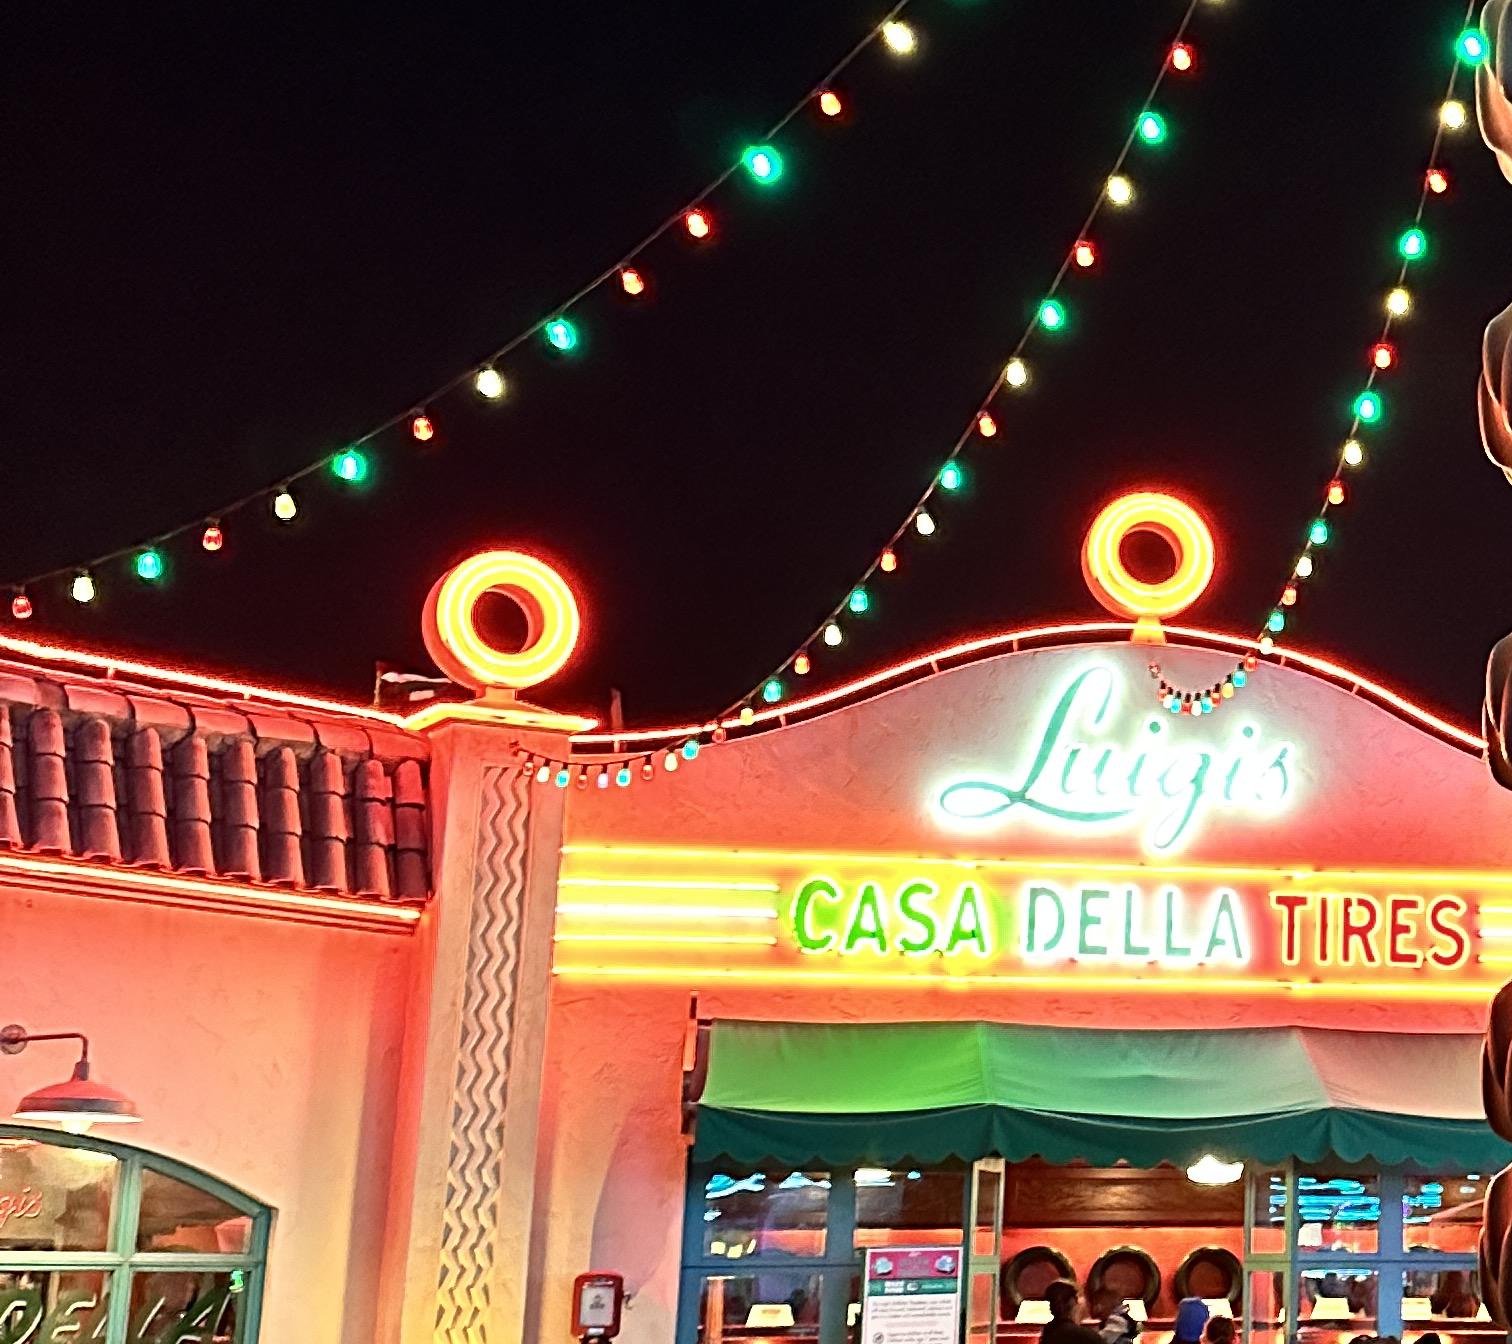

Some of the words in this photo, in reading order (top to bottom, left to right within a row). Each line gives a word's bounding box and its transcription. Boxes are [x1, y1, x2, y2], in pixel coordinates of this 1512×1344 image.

[793, 879, 990, 955] CASA
[1028, 886, 1245, 961] DELLA
[1271, 893, 1468, 967] TIRES
